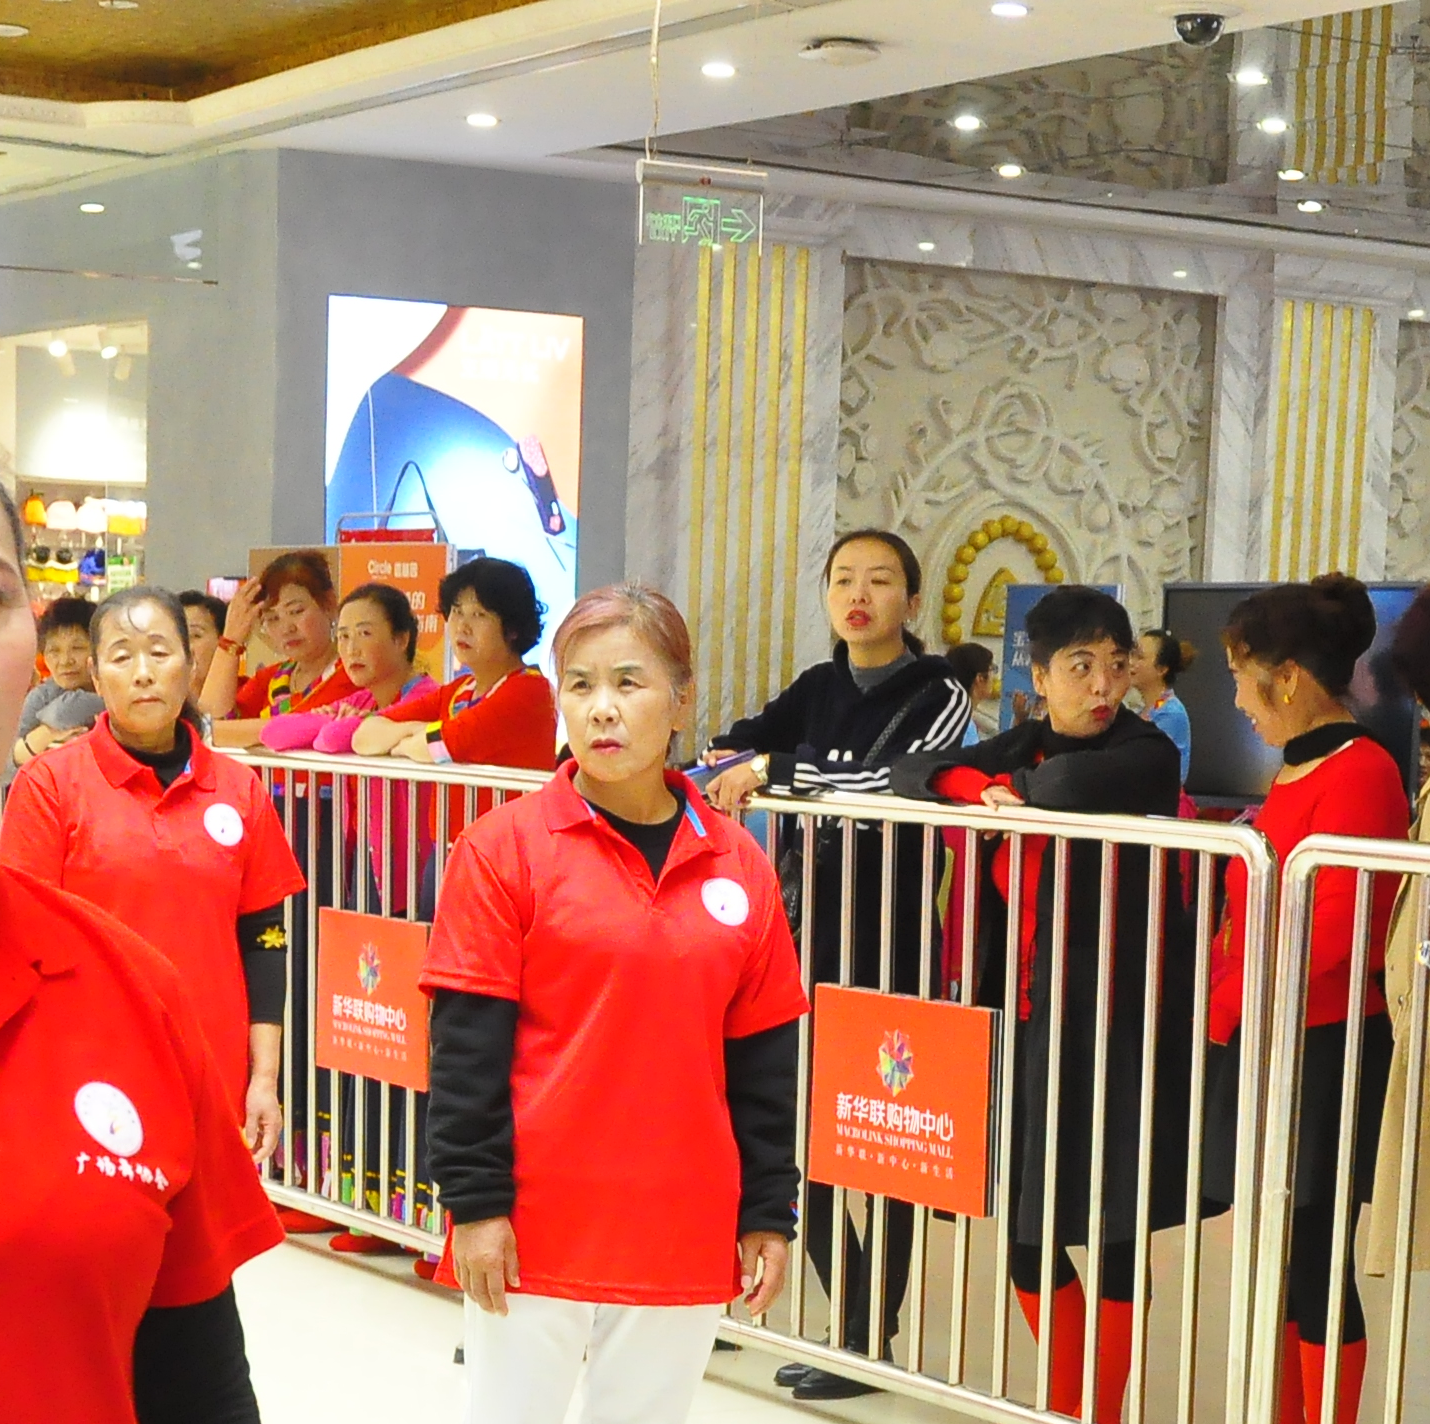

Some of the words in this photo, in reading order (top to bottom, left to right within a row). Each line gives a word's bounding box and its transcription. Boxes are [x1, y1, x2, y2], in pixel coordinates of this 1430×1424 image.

[332, 993, 407, 1031] 新华联购物中心
[836, 1091, 954, 1142] 新华联购物中心
[836, 1123, 884, 1145] MACROLINK
[884, 1133, 928, 1154] SHOPPING
[928, 1142, 954, 1160] MALL
